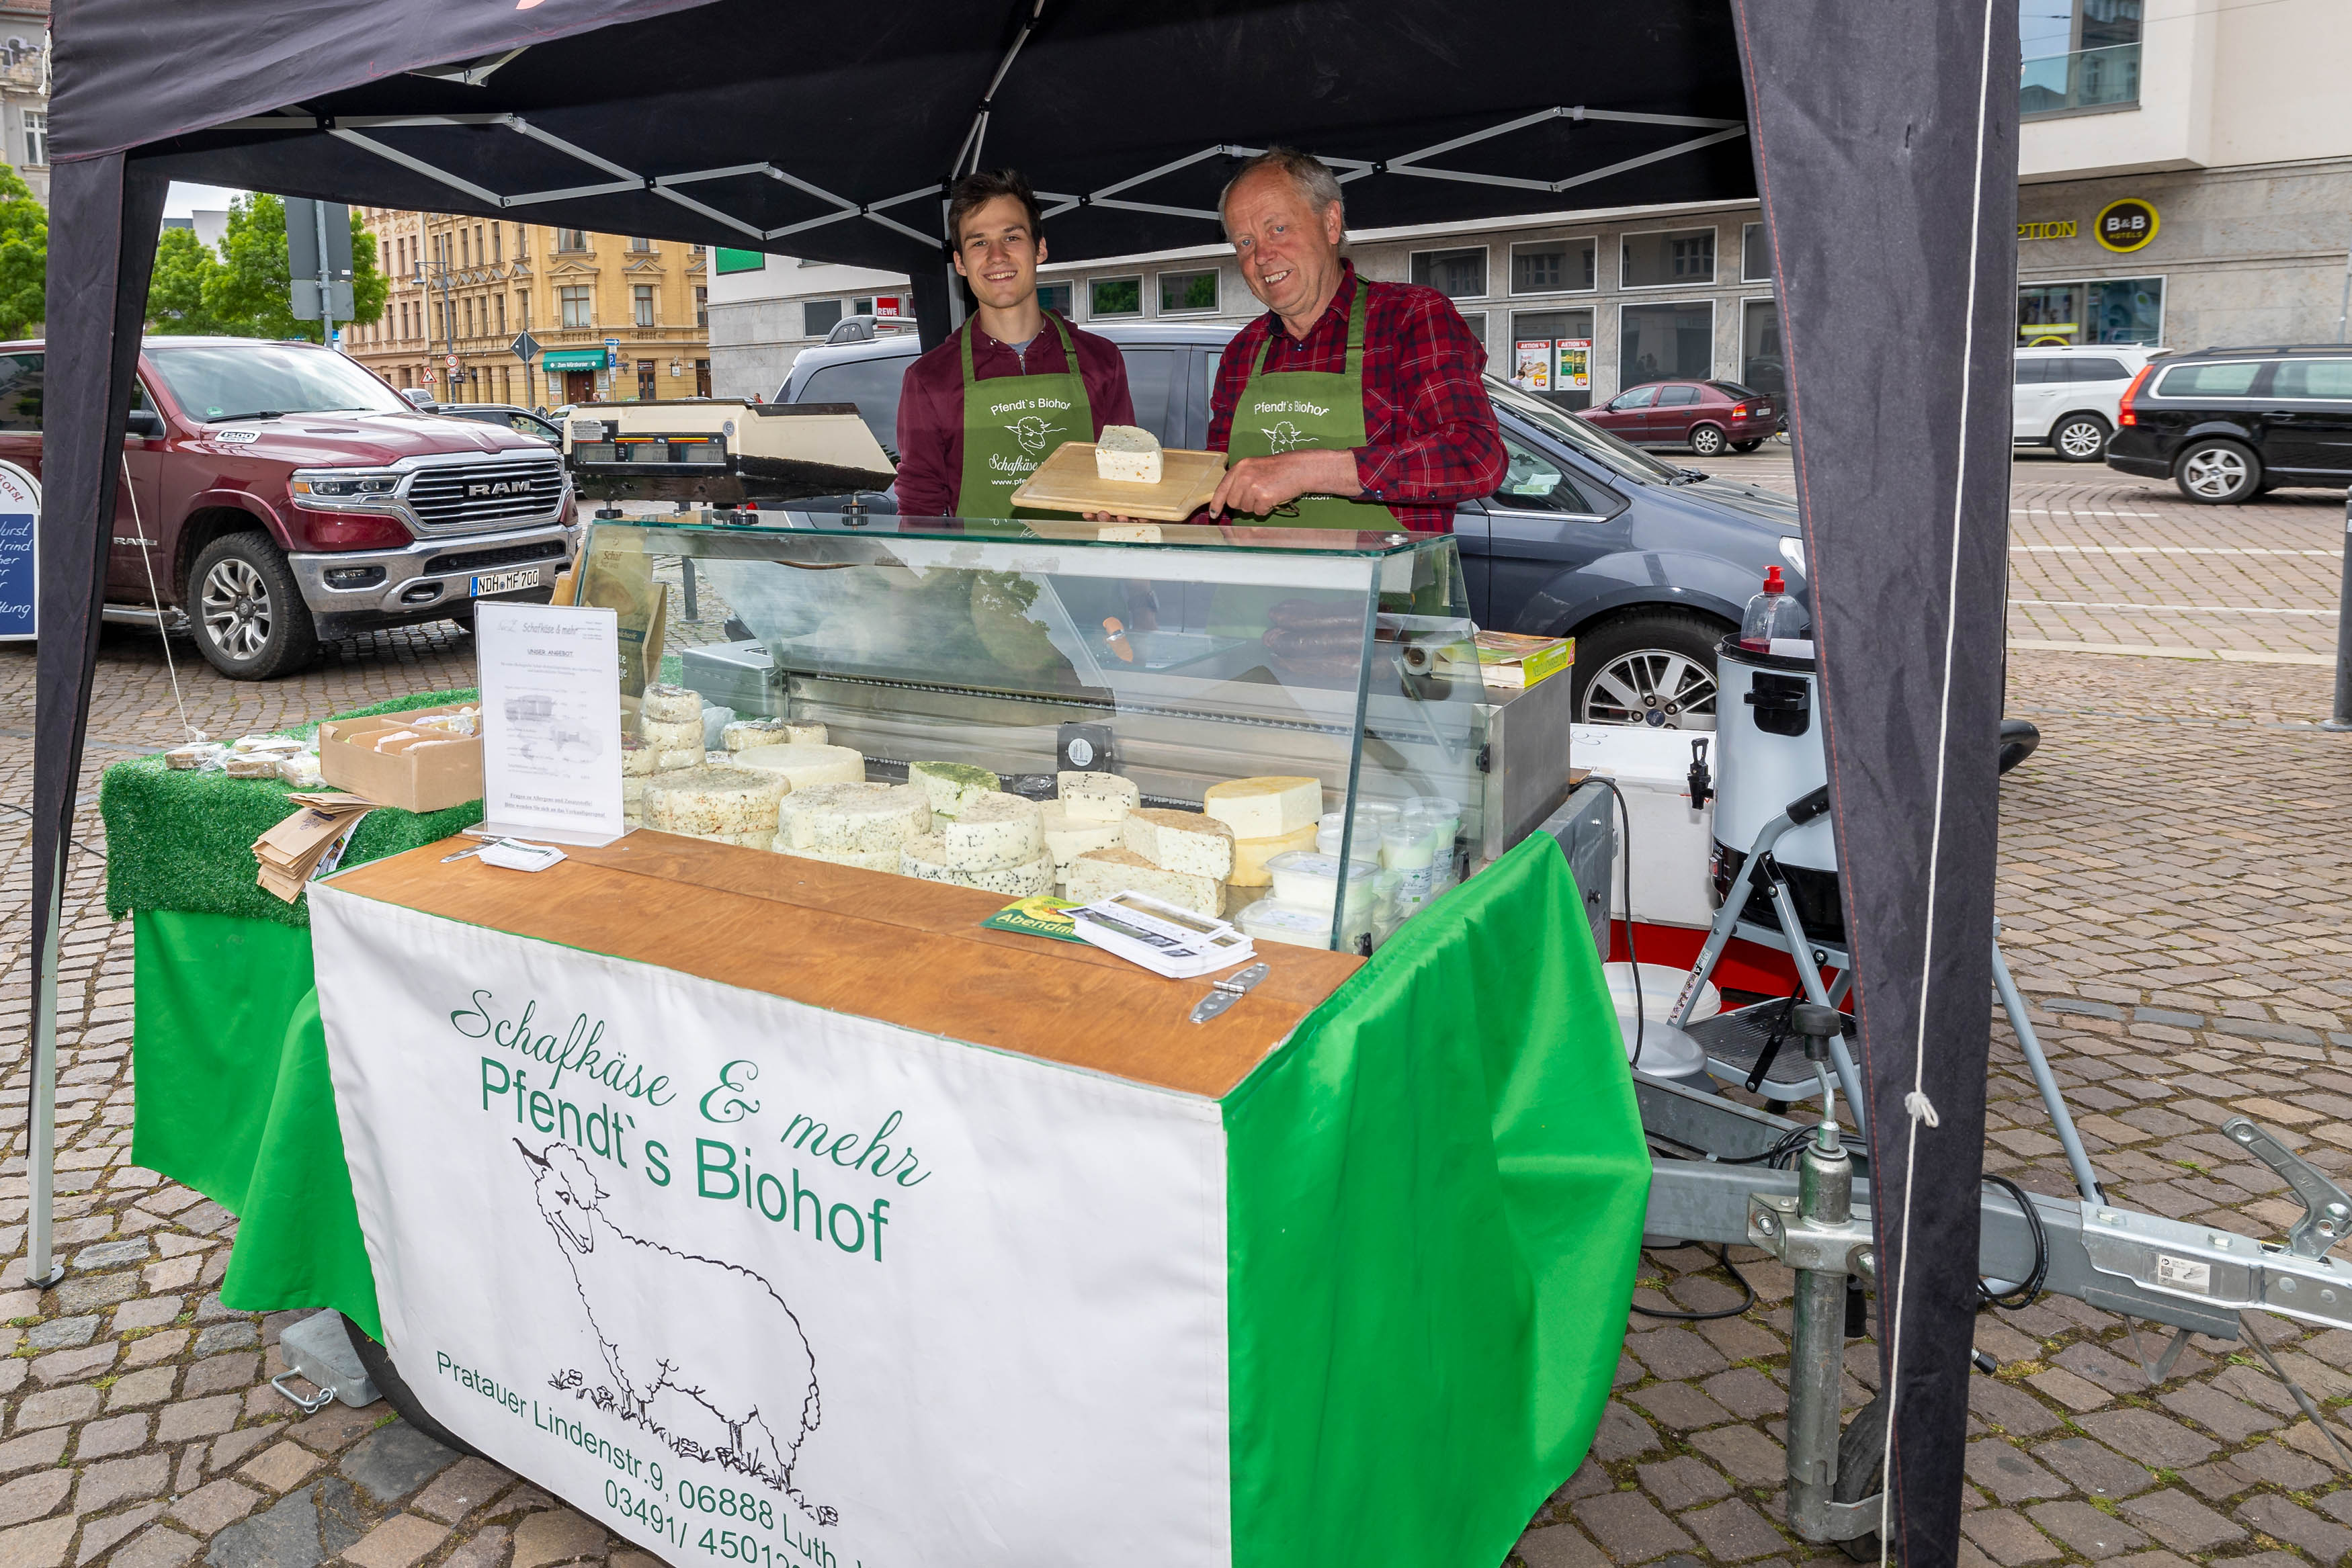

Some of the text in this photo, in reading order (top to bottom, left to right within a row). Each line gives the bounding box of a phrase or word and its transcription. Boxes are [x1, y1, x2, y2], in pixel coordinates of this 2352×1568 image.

[2107, 215, 2146, 231] B&B
[877, 307, 897, 316] REWE
[1038, 398, 1071, 410] Biohof
[1294, 401, 1330, 417] Biohof
[989, 453, 1038, 476] Schafkäse
[469, 480, 530, 496] RAM
[114, 537, 148, 546] RAM
[478, 570, 538, 593] NDH MF 700
[527, 648, 546, 656] UNSER
[996, 913, 1074, 934] Abendm
[451, 989, 931, 1186] Schafkäse & mehr
[696, 1137, 890, 1262] Biohof
[437, 1350, 527, 1418] Pratauer
[678, 1479, 774, 1530] 06888
